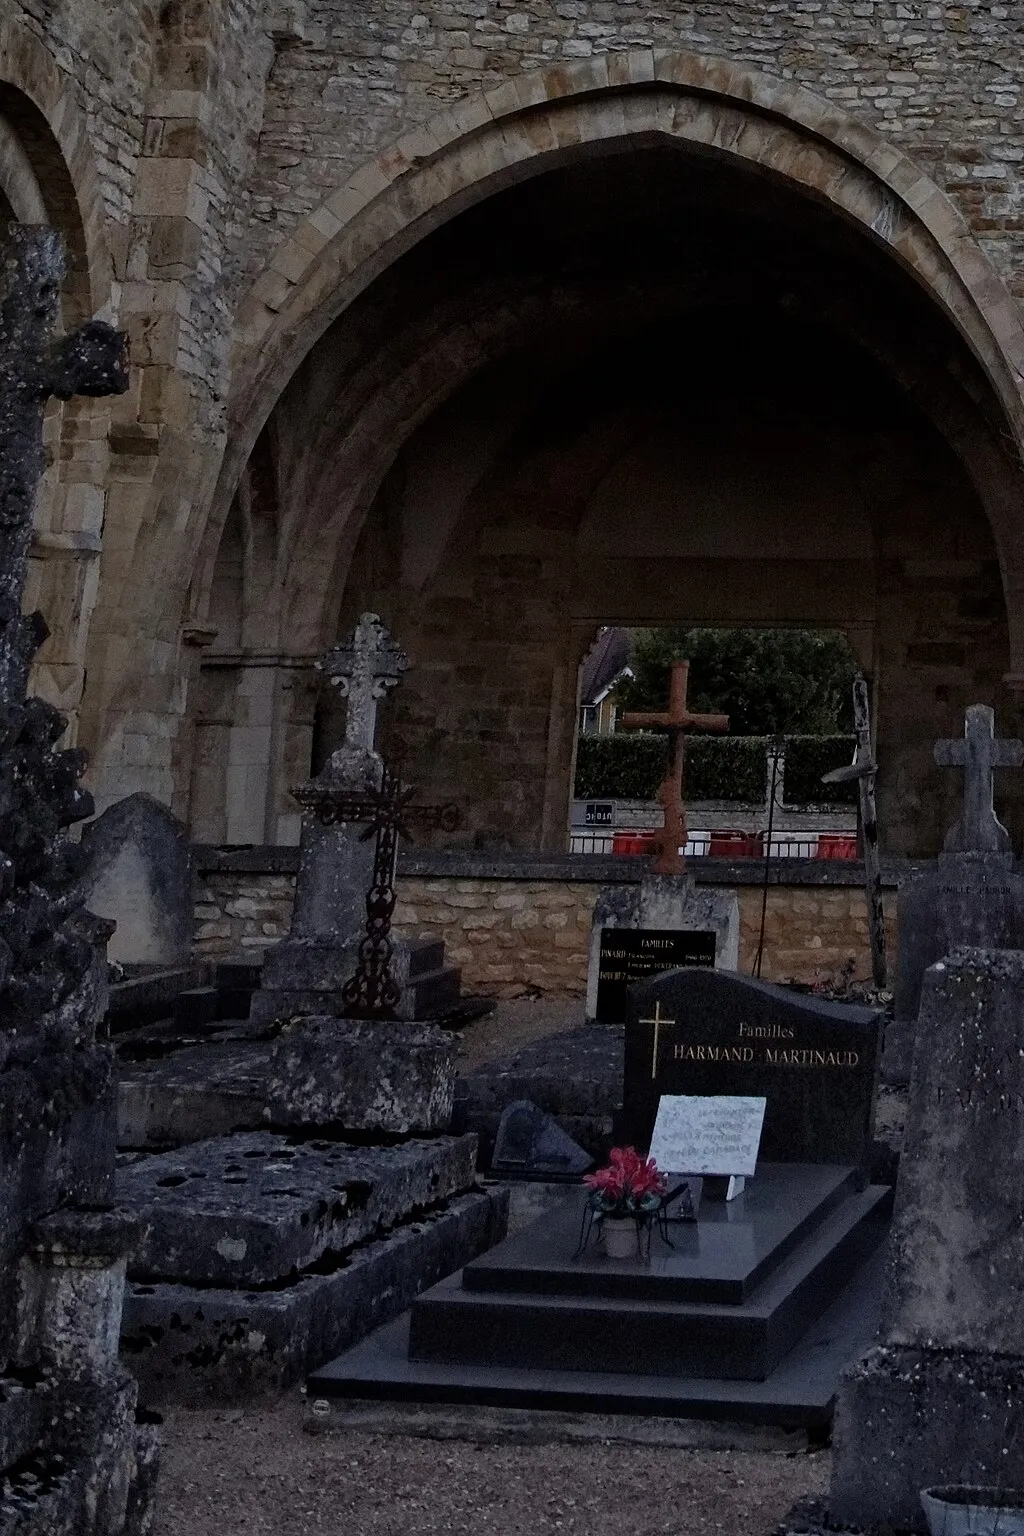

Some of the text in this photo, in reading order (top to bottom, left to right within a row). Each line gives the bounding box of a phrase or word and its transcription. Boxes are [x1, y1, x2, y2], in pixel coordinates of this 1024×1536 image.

[641, 938, 675, 949] FAMILLES
[739, 1022, 794, 1039] Familles
[673, 1045, 860, 1066] HARMAND MARTINAUD
